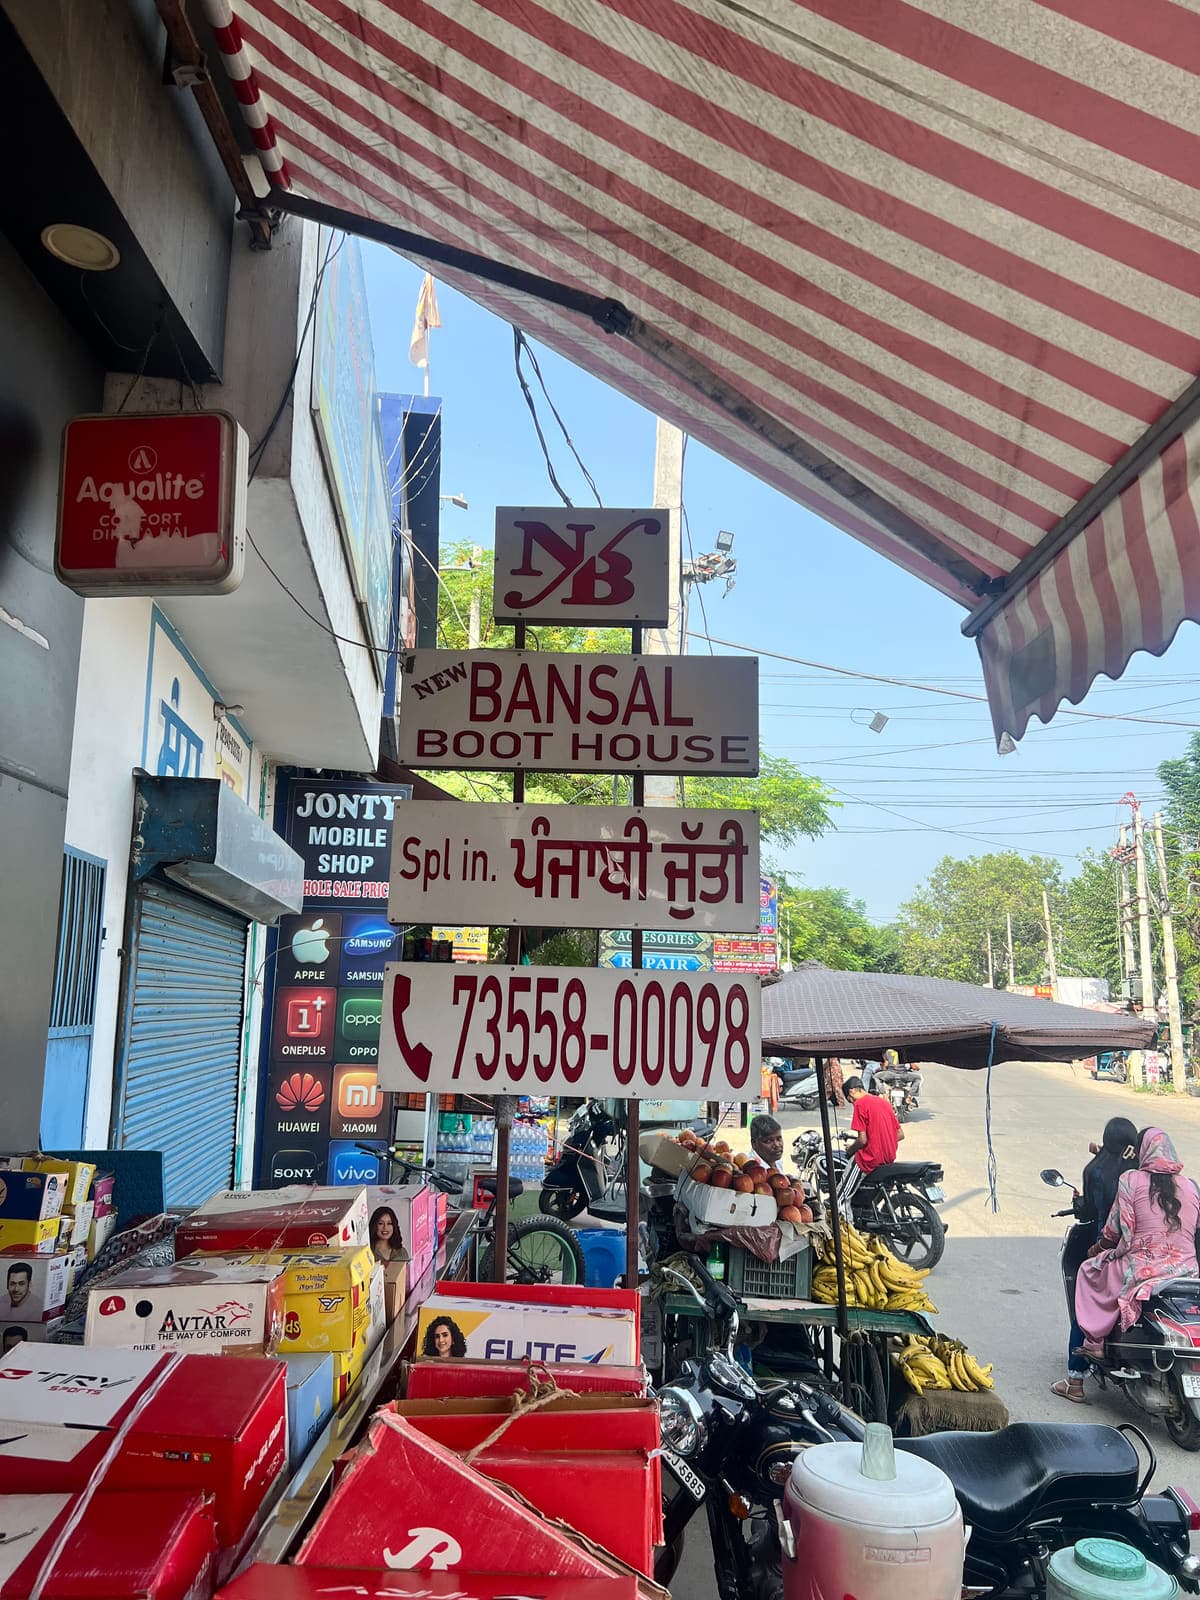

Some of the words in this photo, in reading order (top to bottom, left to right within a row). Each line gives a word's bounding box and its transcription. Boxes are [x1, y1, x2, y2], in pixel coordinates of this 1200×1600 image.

[76, 471, 205, 503] Aqualite
[99, 513, 182, 526] COFORT
[410, 662, 467, 700] NEW
[468, 661, 694, 727] BANSAL
[416, 729, 554, 760] BOOT
[571, 733, 750, 764] HOUSE
[296, 792, 403, 821] JONTY
[308, 826, 388, 848] MOBILE
[317, 854, 375, 874] SHOP
[400, 836, 451, 892] Spl
[462, 838, 497, 882] in.
[510, 816, 653, 900] ਪੰਜਾਬੀ
[661, 819, 749, 920] ਜੁੱਤੀ
[333, 880, 361, 898] SALE
[349, 938, 392, 948] SAMSUNG
[617, 933, 695, 945] ACESORIES
[621, 957, 689, 971] RPAIR
[294, 970, 326, 980] APPLE
[347, 971, 385, 981] SAMSUN
[451, 974, 750, 1089] 73558-00098
[281, 1045, 327, 1056] ONEPLUS
[349, 1046, 378, 1057] OPPO
[277, 1122, 320, 1133] HUAWEI
[342, 1123, 377, 1134] XIAOMI
[273, 1168, 315, 1178] SONY
[337, 1165, 377, 1180] vivo
[158, 1309, 227, 1332] AVTAR
[158, 1333, 174, 1341] THE
[176, 1332, 195, 1340] WAY
[196, 1331, 209, 1339] OF
[210, 1329, 252, 1338] COMFORT
[679, 1464, 705, 1496] 5885
